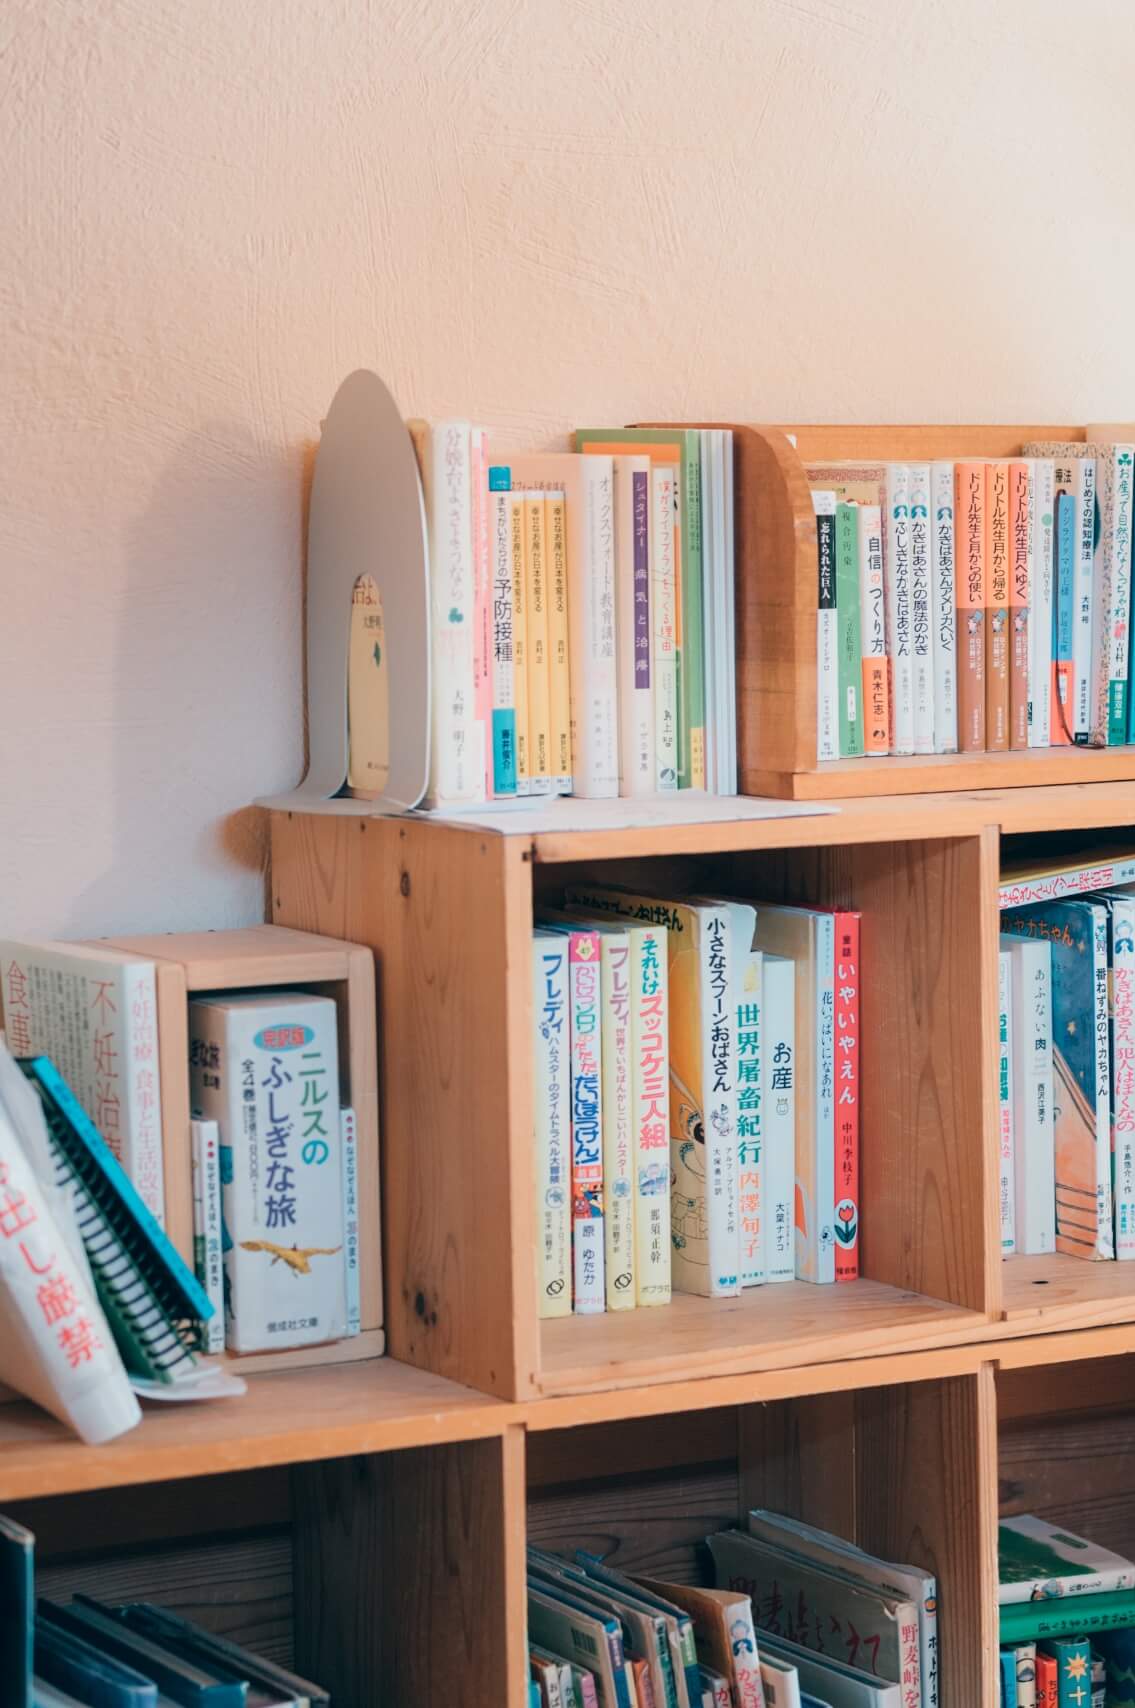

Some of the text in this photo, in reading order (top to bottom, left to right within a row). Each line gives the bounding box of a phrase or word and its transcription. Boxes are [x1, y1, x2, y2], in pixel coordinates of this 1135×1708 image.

[820, 522, 832, 600] 忘れられた巨人
[968, 472, 983, 602] ドリトル先生と月からの使い
[993, 472, 1007, 601] ドリトル先生月から帰る
[1016, 472, 1029, 599] ドリトル先生月へゆく
[1082, 467, 1093, 560] はじめての認知療法
[868, 536, 884, 654] 自信のつくり方
[872, 668, 884, 716] 青木仁志
[706, 917, 732, 1094] 小さなスプーンおばさん
[819, 991, 834, 1100] 花いっぱいになあれ
[838, 962, 857, 1107] いやいやえん
[1095, 967, 1108, 1097] 番ねずみのヤカちゃん
[298, 1051, 329, 1166] ニルスの
[735, 1003, 762, 1166] 世界屠畜紀行
[771, 1041, 793, 1091] お産
[261, 1056, 298, 1230] ふしぎな旅
[581, 1224, 596, 1286] 原 ゆたか
[738, 1171, 761, 1259] 内澤旬子
[266, 1317, 318, 1334] 偕成社文庫
